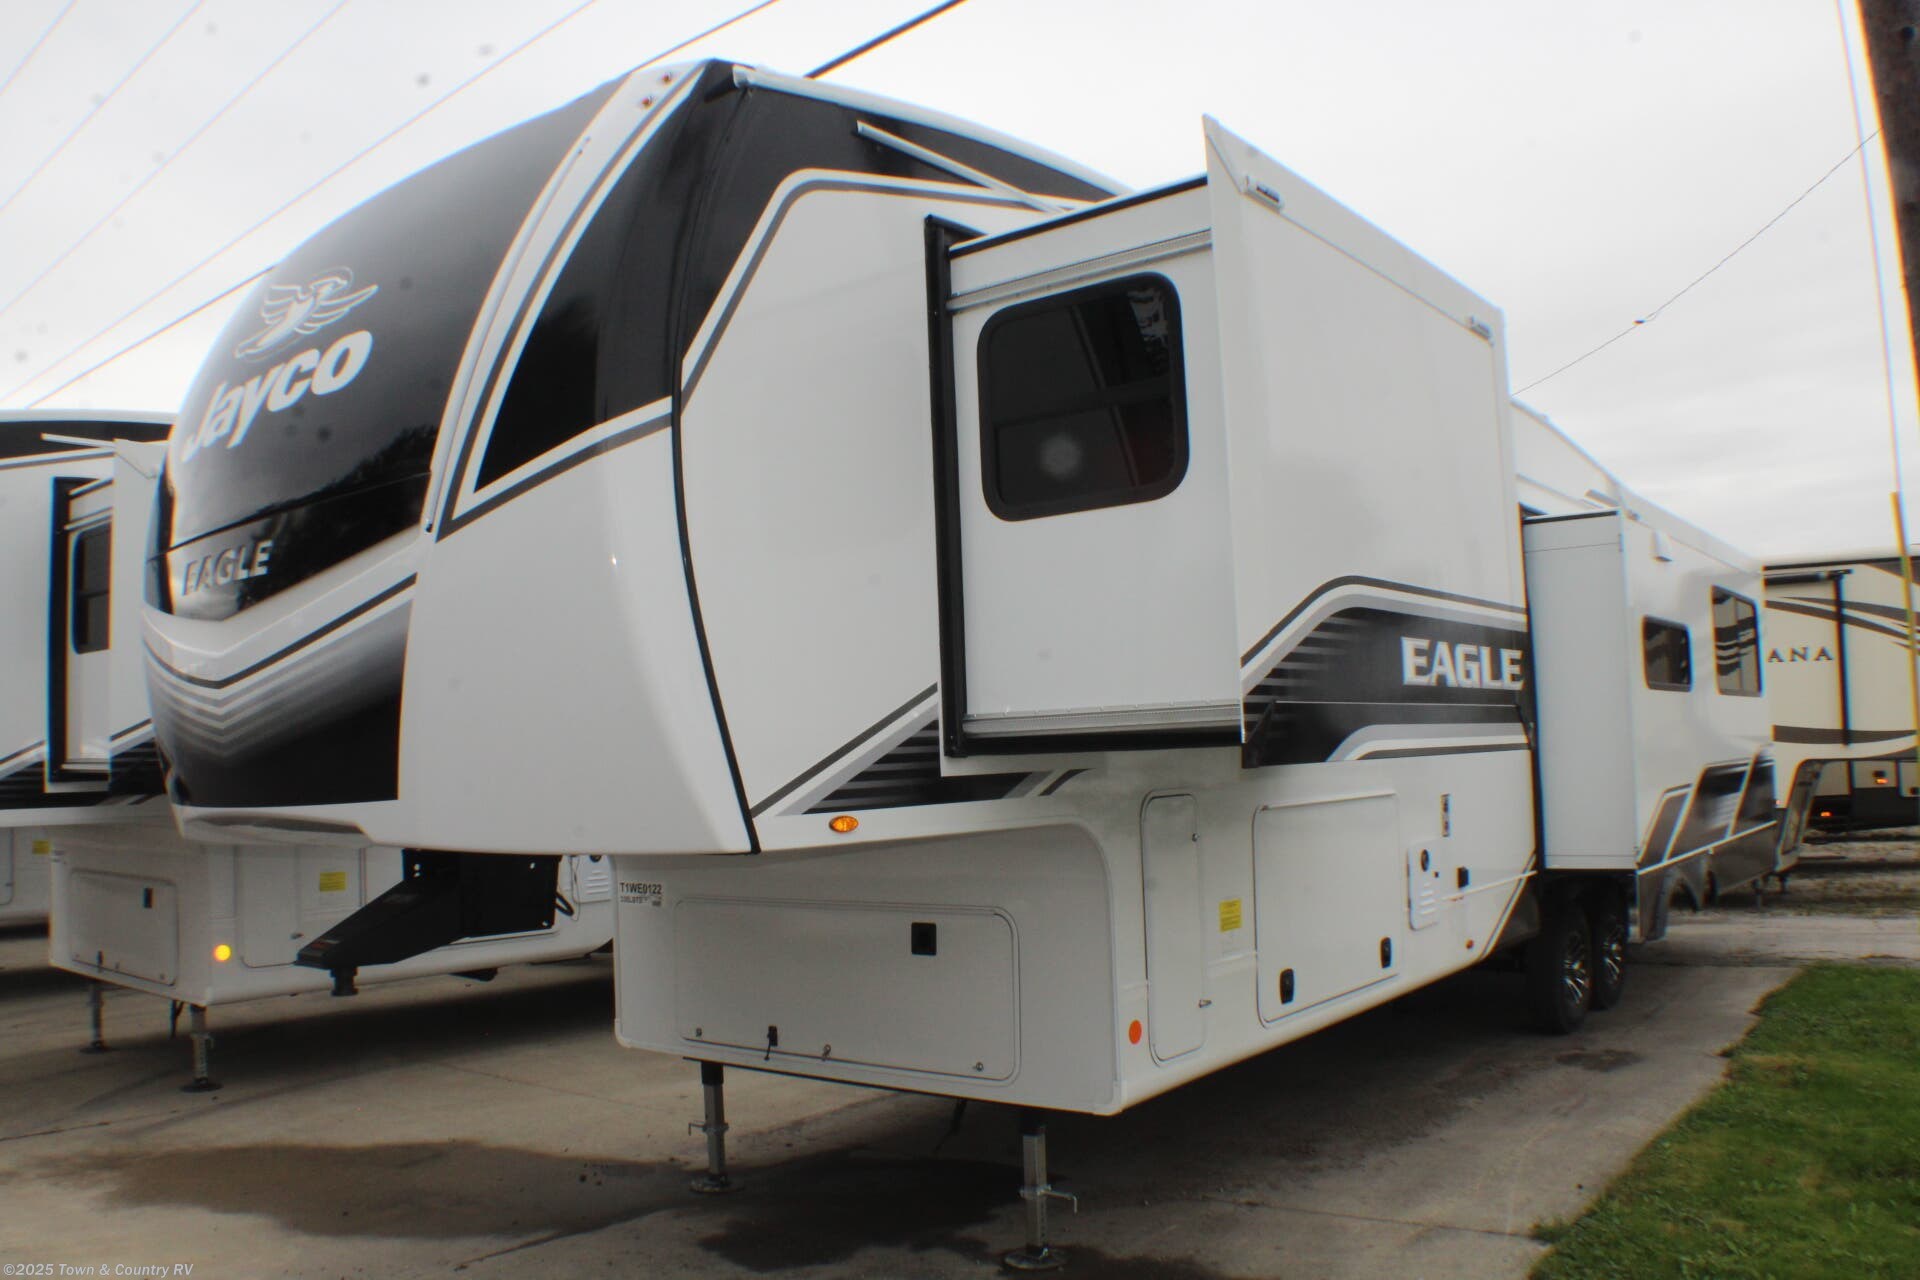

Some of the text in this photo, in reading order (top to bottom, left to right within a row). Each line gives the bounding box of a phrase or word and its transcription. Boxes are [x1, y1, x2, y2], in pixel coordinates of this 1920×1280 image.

[180, 329, 373, 463] Jayco
[181, 539, 273, 596] EAGLE
[1400, 636, 1524, 691] EAGLE
